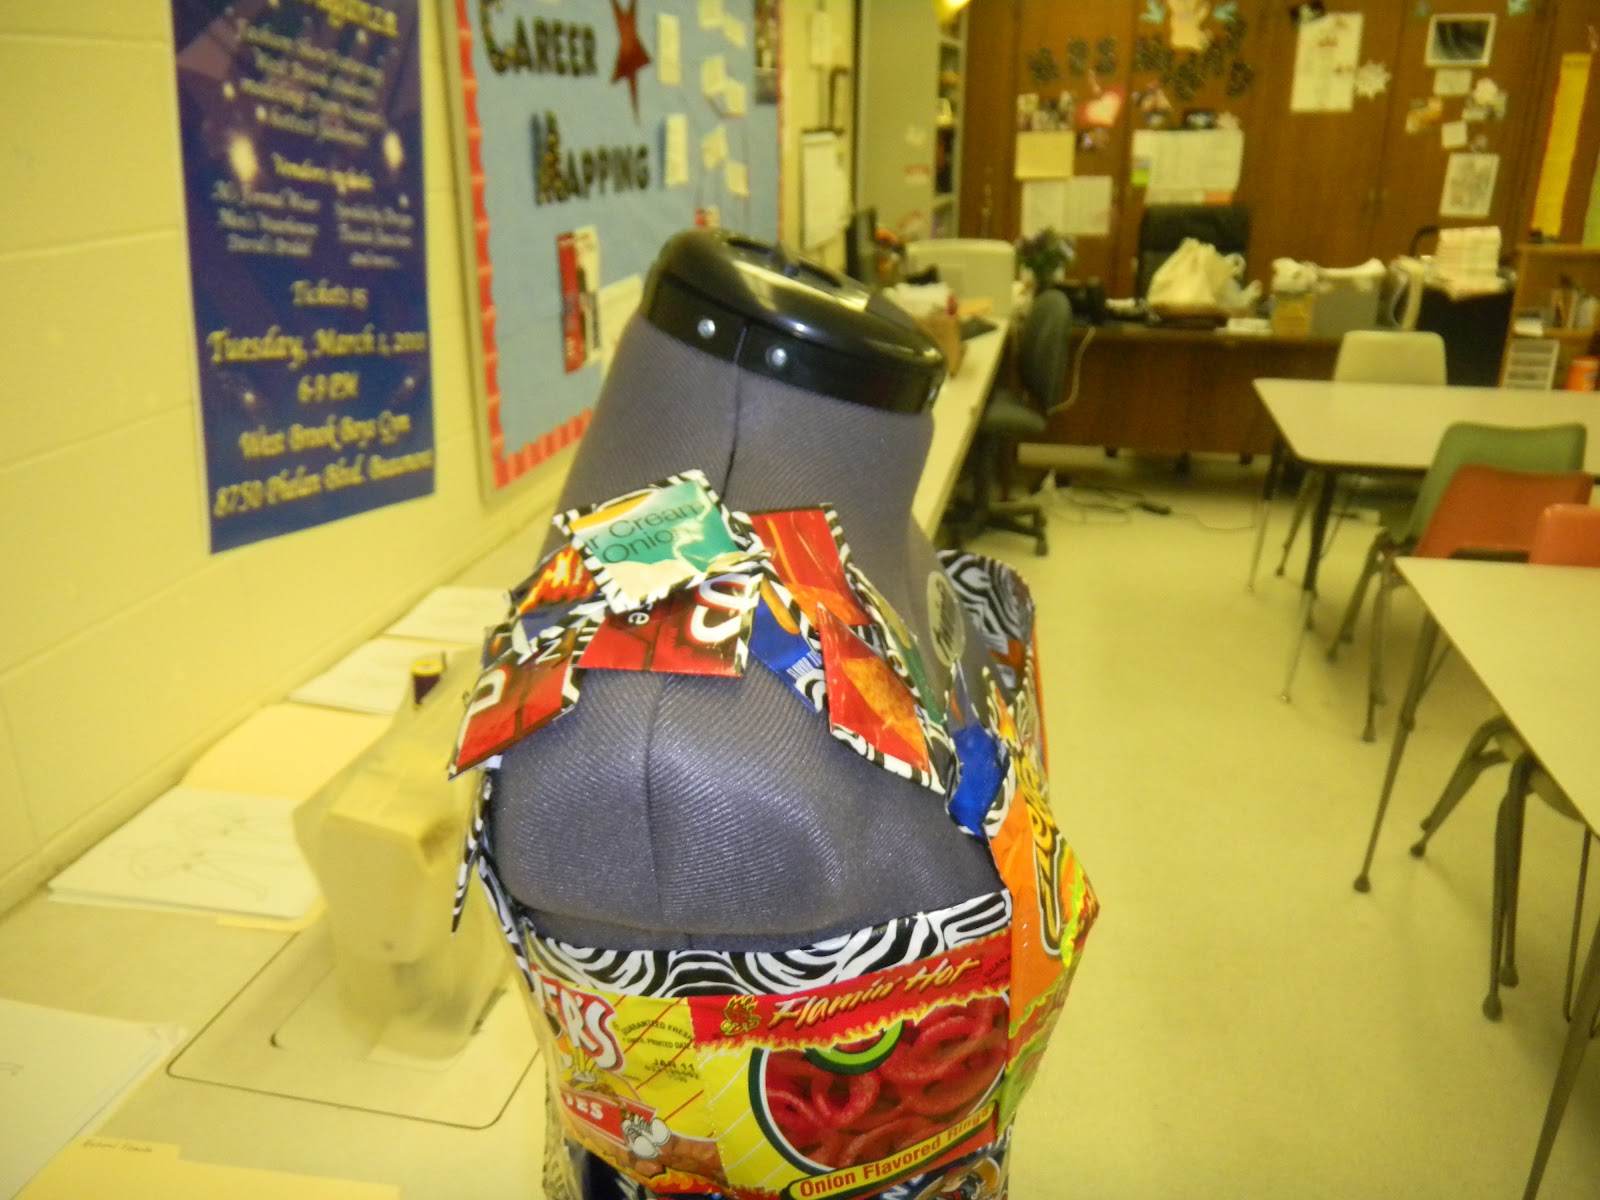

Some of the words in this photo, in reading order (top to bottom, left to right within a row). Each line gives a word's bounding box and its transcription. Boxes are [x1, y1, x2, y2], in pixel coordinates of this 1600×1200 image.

[479, 0, 598, 76] CAREER
[207, 324, 308, 369] Tuesday,
[312, 323, 375, 356] March
[602, 529, 675, 564] Onio
[767, 976, 904, 1030] Flamin'
[904, 957, 981, 994] Hot
[800, 1171, 856, 1198] Onion
[863, 1138, 941, 1180] Flavored
[947, 1106, 990, 1141] Rings
